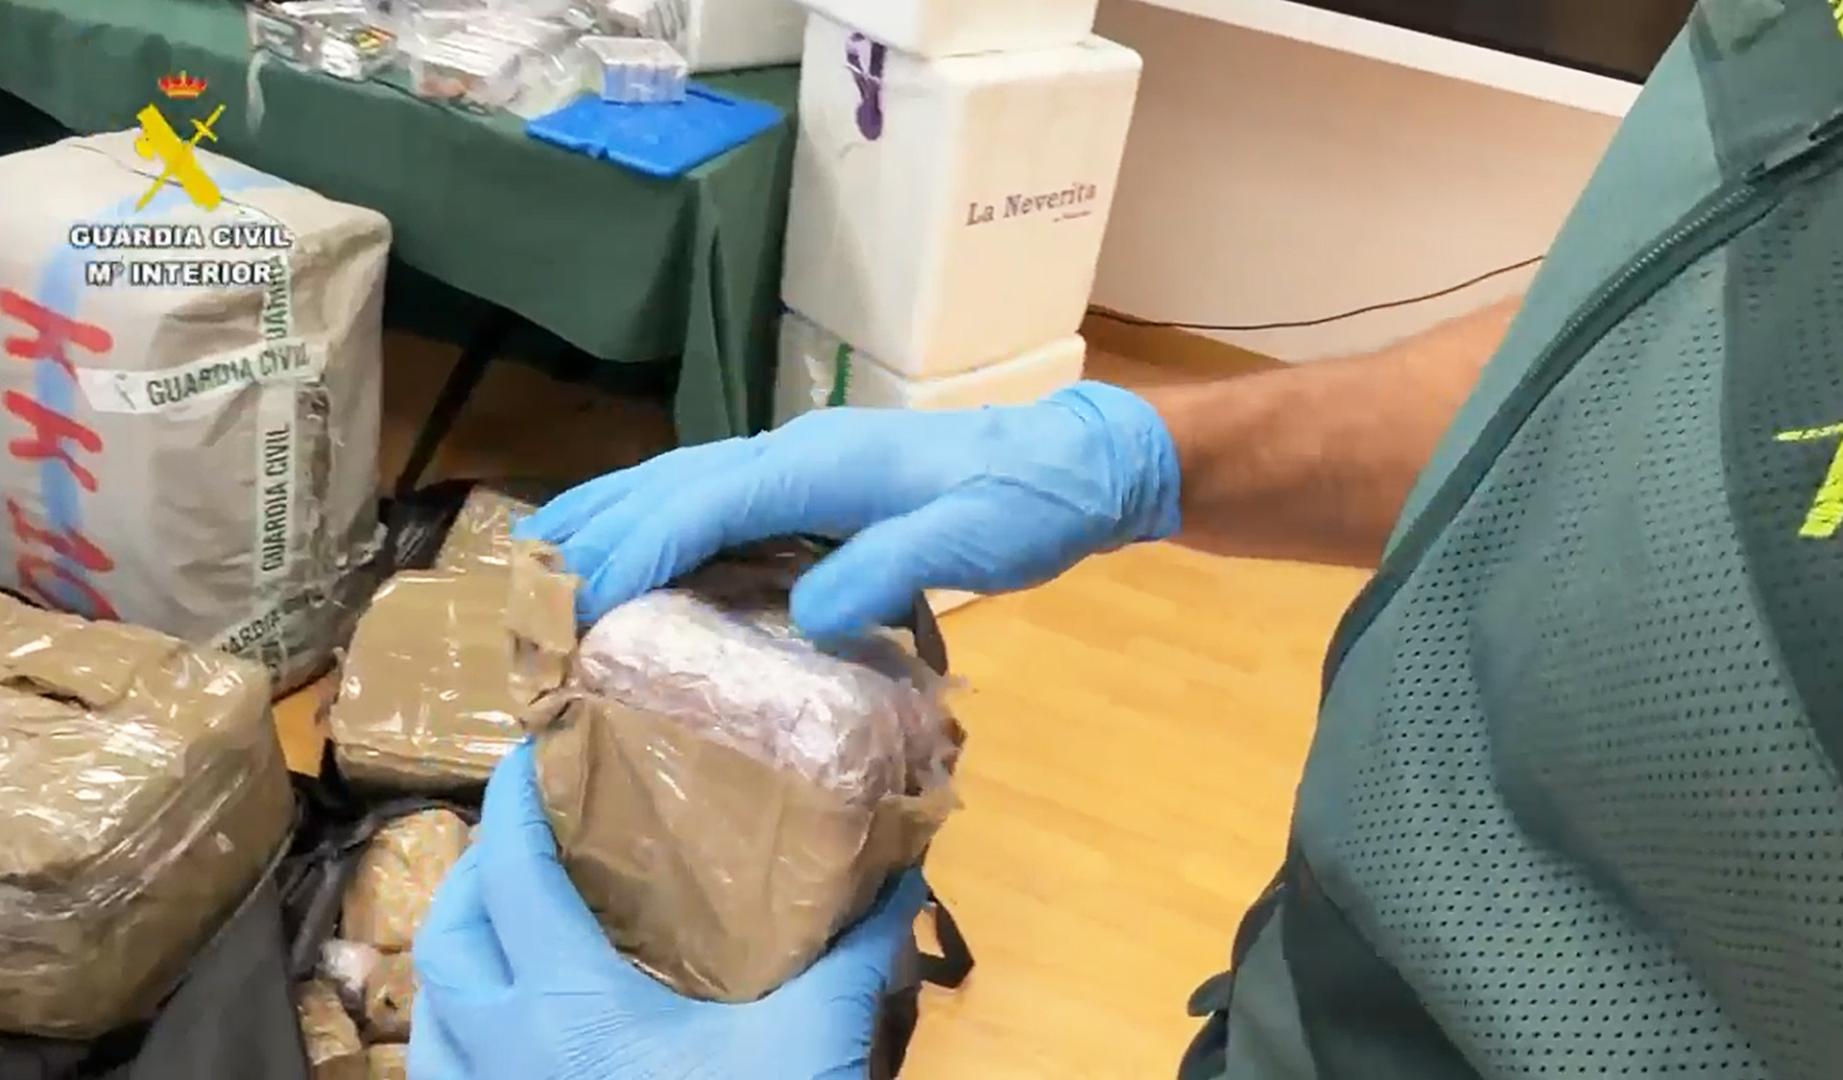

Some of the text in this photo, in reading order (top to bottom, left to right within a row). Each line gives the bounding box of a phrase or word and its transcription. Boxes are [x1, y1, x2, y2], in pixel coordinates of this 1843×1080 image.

[965, 202, 995, 226] La
[1002, 181, 1097, 219] Neverita
[147, 342, 310, 406] GUARDIA CIVIL
[261, 424, 290, 571] GUARDIA CIVIL
